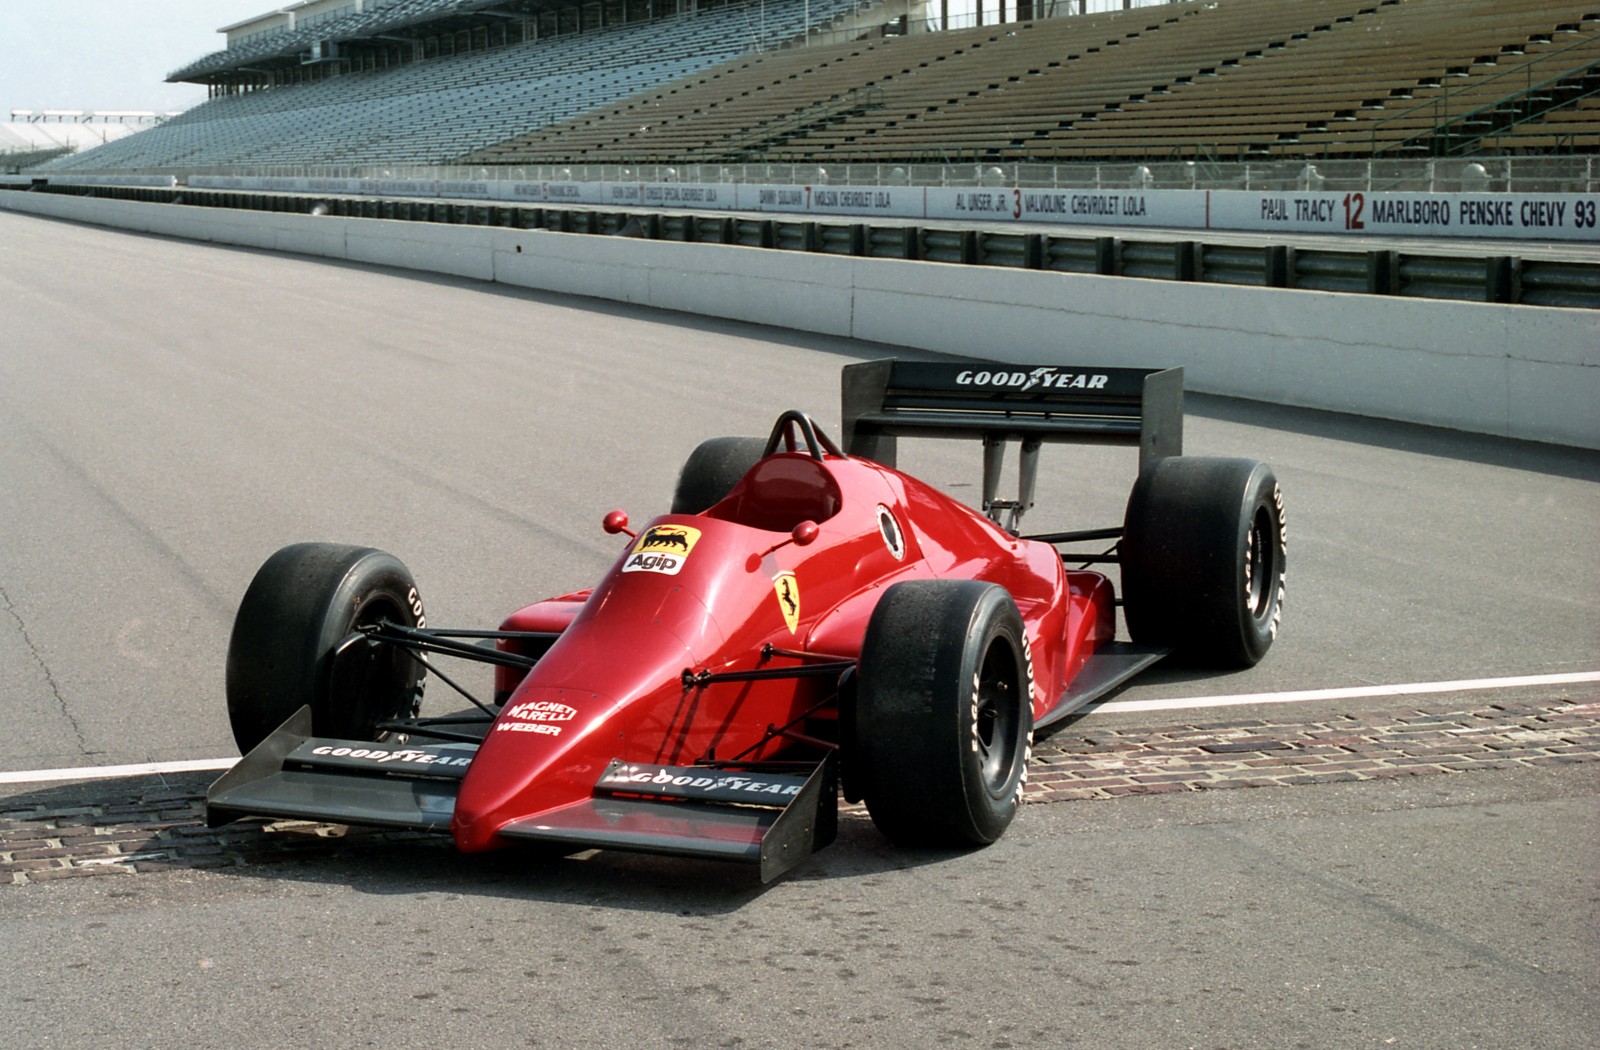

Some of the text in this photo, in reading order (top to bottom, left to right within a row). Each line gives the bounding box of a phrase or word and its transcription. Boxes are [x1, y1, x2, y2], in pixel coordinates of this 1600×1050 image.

[805, 186, 812, 209] 7
[956, 193, 966, 211] AL
[1013, 189, 1022, 219] 3
[1024, 194, 1067, 214] VALVOLINE
[1071, 194, 1119, 216] CHEVROLET
[1123, 195, 1147, 217] LOLA
[1261, 192, 1597, 230] PAUL TRACY 12 MARLBORO PENSKE CHEVY 93
[627, 553, 677, 571] Agip
[496, 722, 562, 737] WEBER
